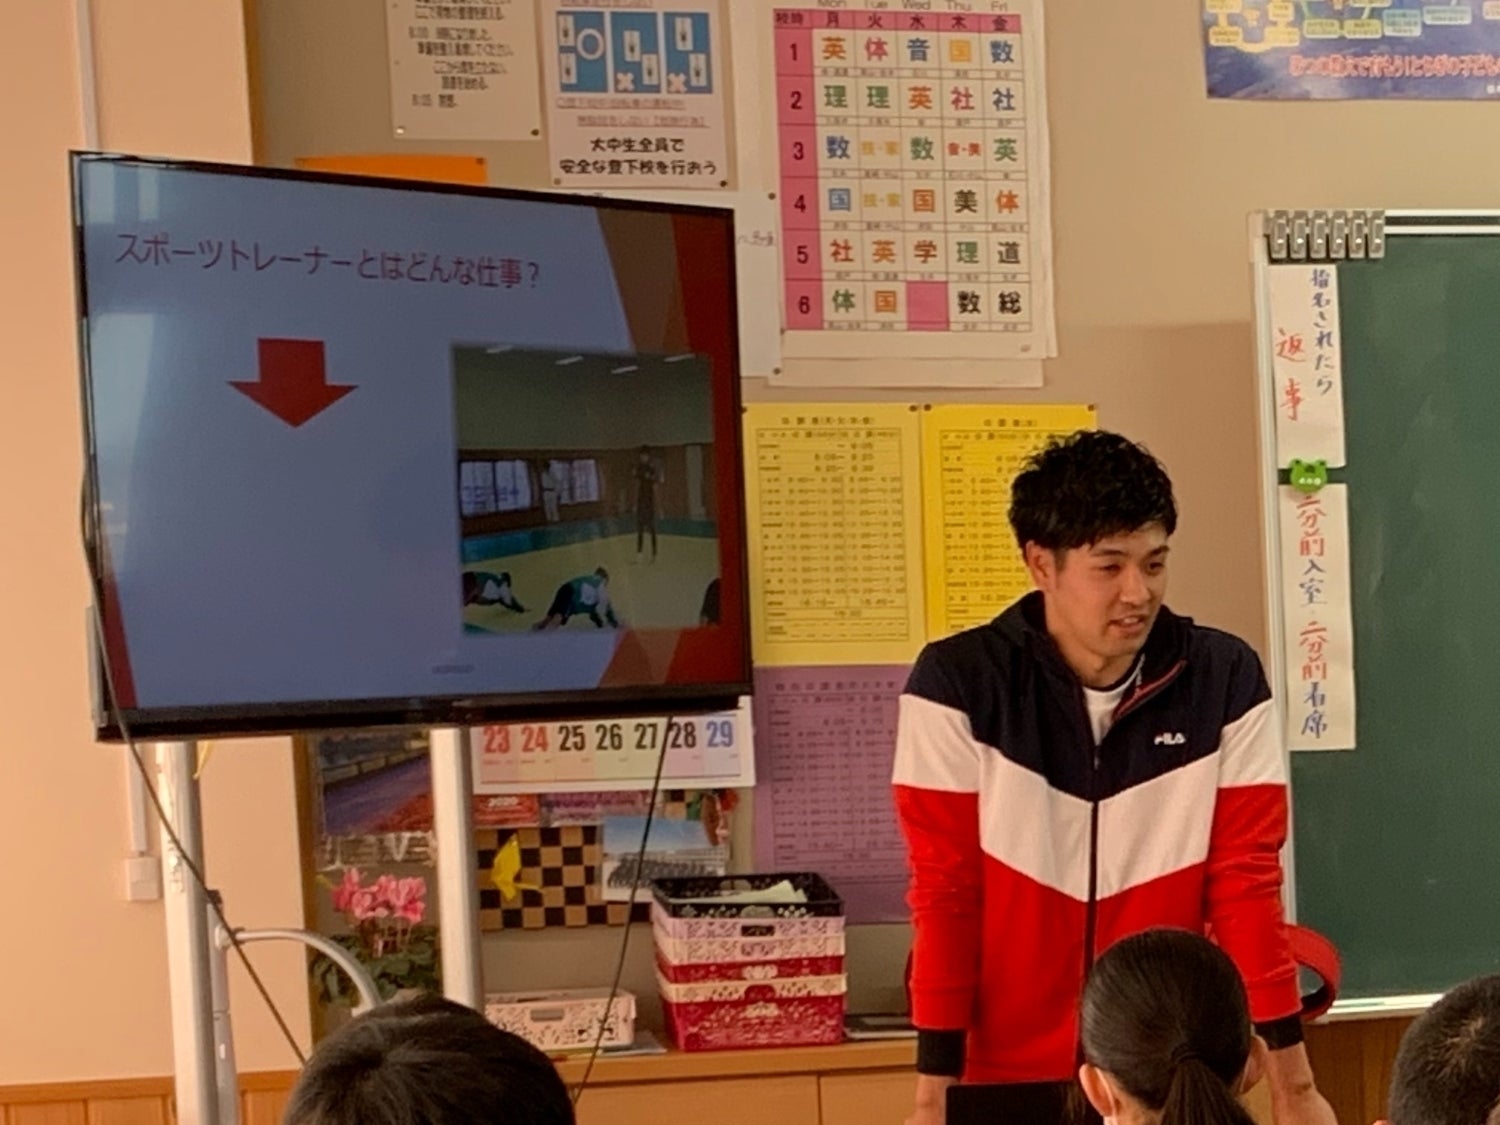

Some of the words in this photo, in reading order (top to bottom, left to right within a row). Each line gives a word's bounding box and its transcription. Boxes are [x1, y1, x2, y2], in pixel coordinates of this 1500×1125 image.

[902, 0, 931, 10] Wed
[947, 0, 972, 11] Thu
[825, 12, 840, 27] 月
[867, 14, 883, 28] 火
[909, 15, 925, 28] 水
[952, 16, 967, 28] 木
[991, 17, 1009, 32] 金
[789, 43, 798, 61] 1
[821, 36, 847, 61] 英
[865, 36, 889, 62] 体
[907, 38, 930, 62] 音
[949, 39, 973, 63] 国
[990, 41, 1014, 64] 数
[789, 90, 803, 110] 2
[823, 85, 848, 109] 理
[866, 85, 891, 109] 理
[908, 86, 933, 110] 英
[951, 86, 975, 111] 社
[992, 87, 1016, 111] 社
[792, 141, 804, 161] 3
[826, 136, 851, 160] 数
[910, 137, 935, 161] 数
[993, 138, 1018, 162] 英
[559, 159, 717, 176] 安全な登下校を行おう
[793, 194, 807, 213] 4
[828, 188, 851, 211] 国
[912, 189, 936, 213] 国
[954, 189, 978, 214] 美
[995, 189, 1020, 214] 体
[796, 245, 809, 264] 5
[830, 239, 854, 263] 社
[872, 240, 896, 263] 英
[914, 240, 938, 264] 学
[956, 241, 980, 264] 理
[997, 241, 1021, 265] 道
[798, 295, 811, 315] 6
[832, 289, 856, 313] 体
[874, 290, 897, 313] 国
[957, 290, 981, 314] 数
[998, 291, 1022, 315] 総
[483, 725, 511, 754] 23
[521, 725, 549, 752] 24
[558, 724, 586, 751] 25
[595, 723, 623, 750] 26
[634, 722, 659, 749] 27
[669, 721, 697, 749] 28
[706, 720, 734, 748] 29
[1154, 732, 1186, 745] FILA
